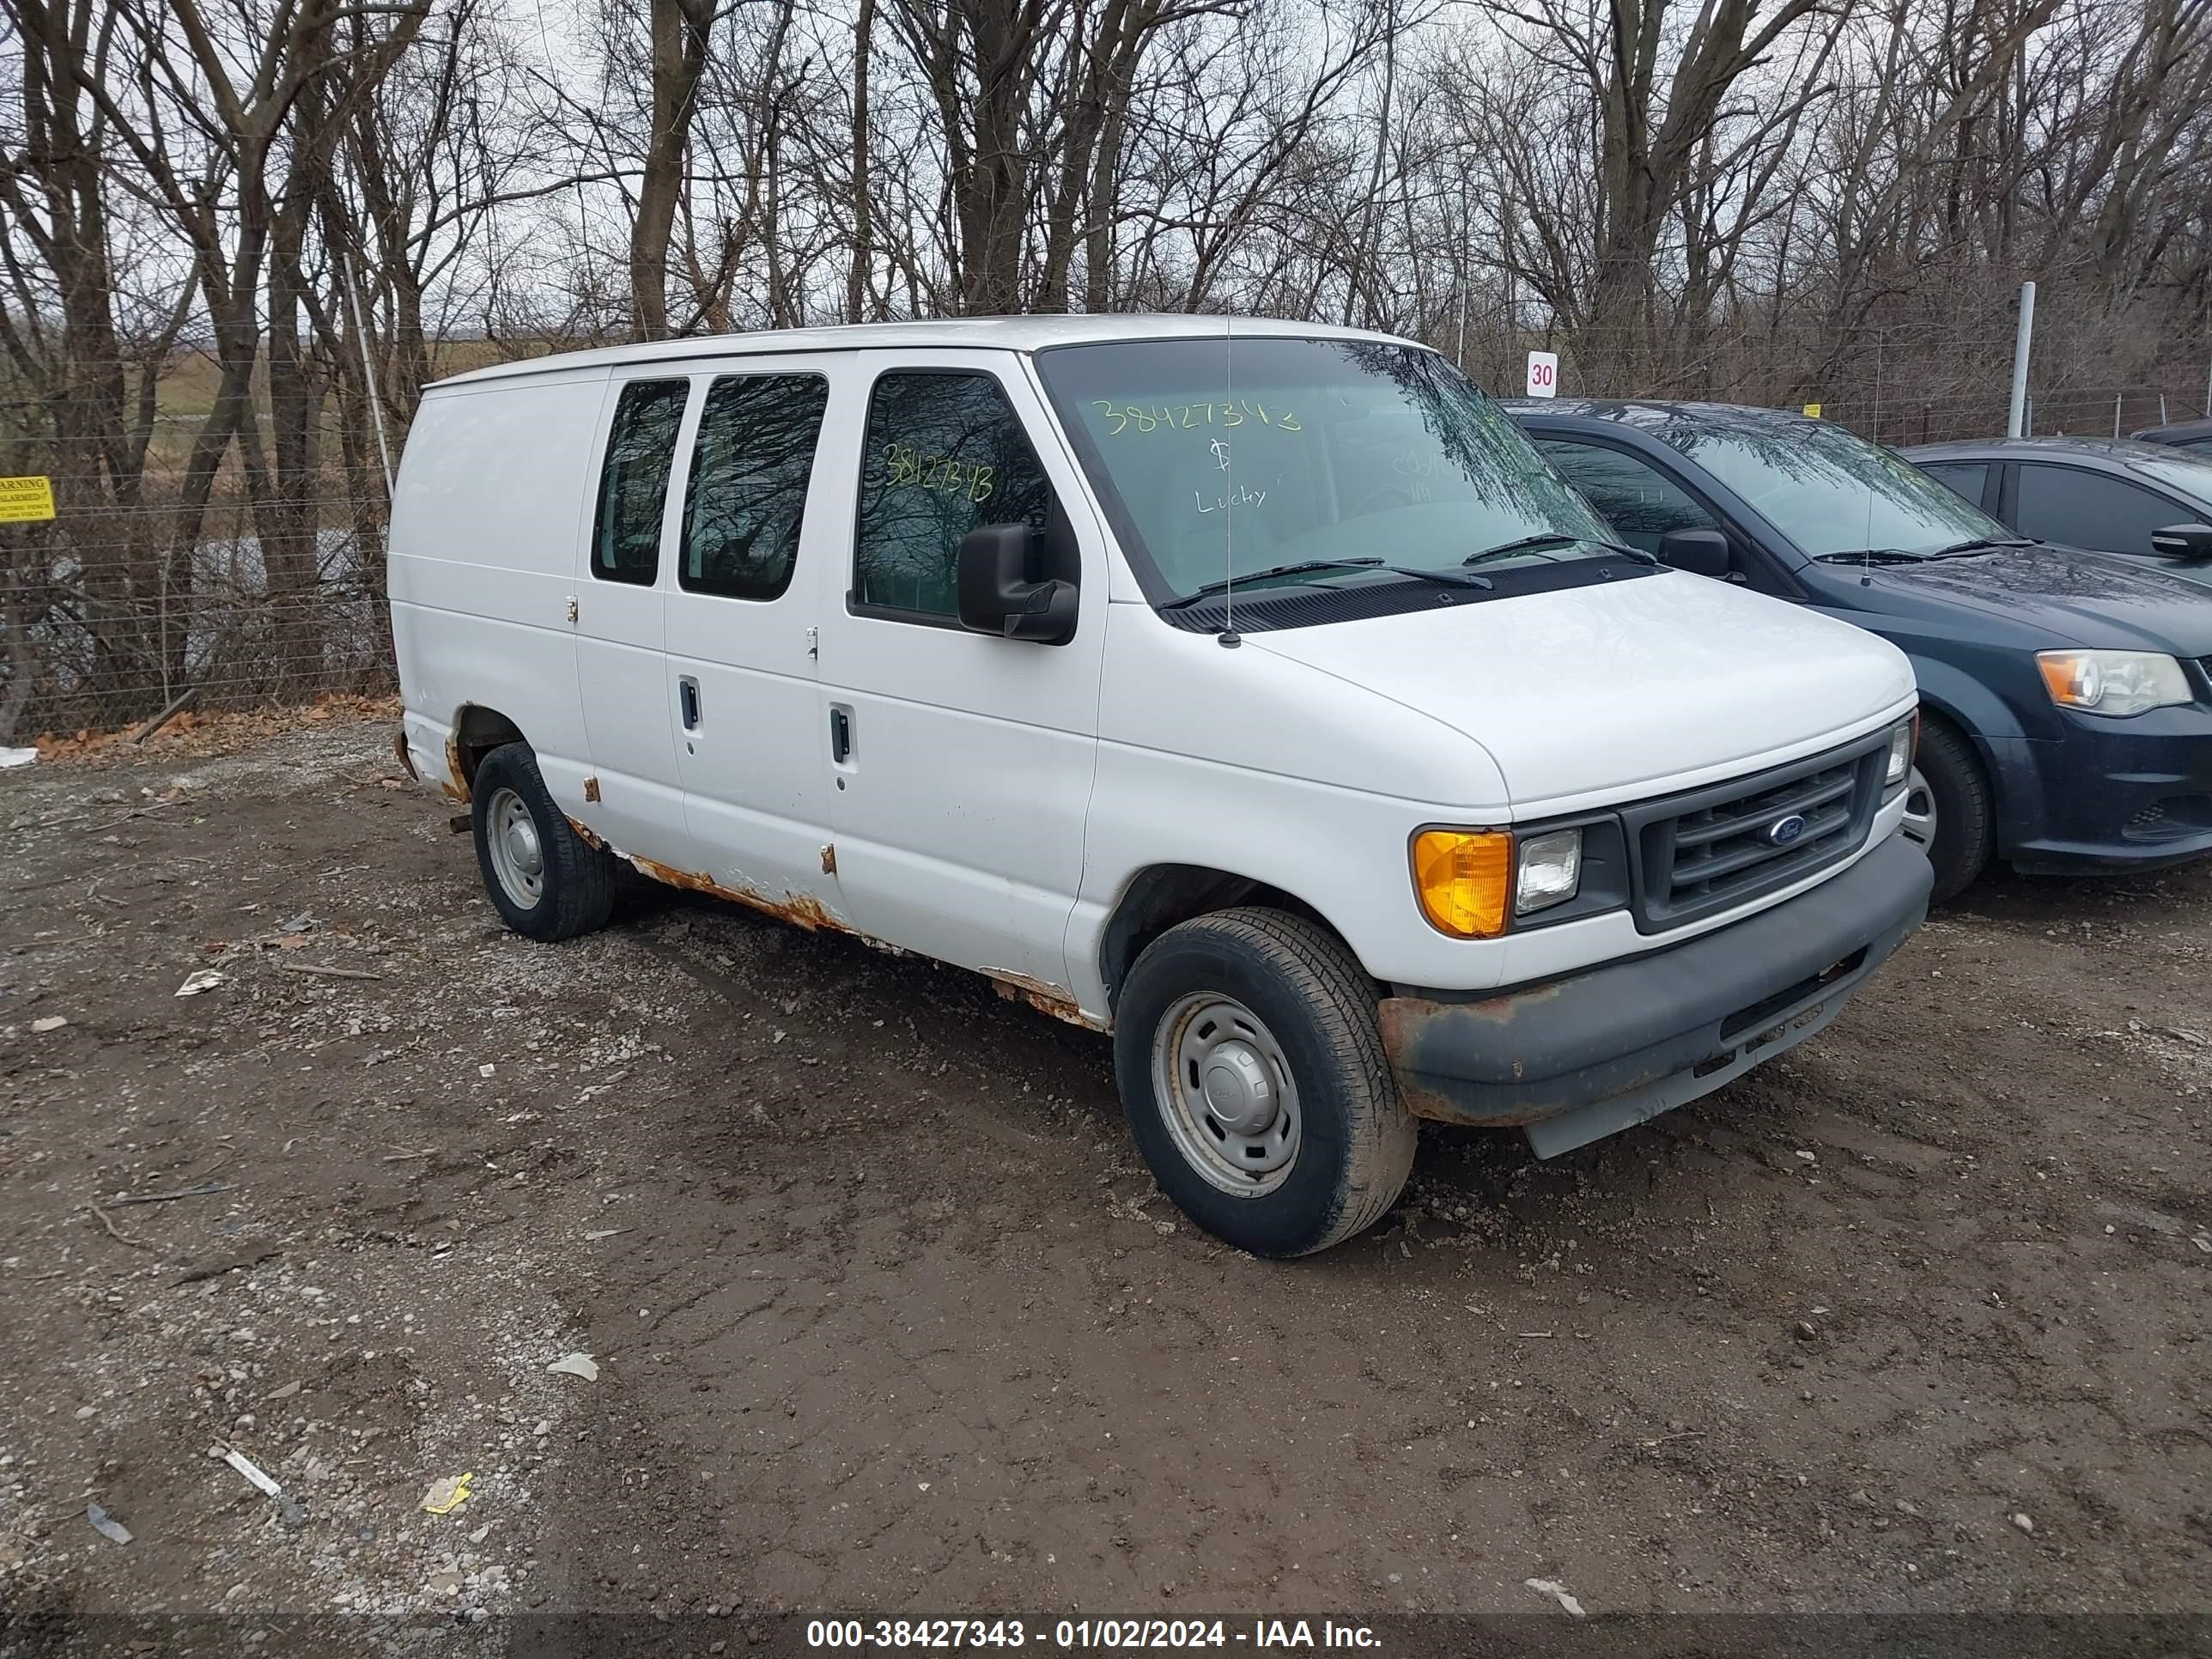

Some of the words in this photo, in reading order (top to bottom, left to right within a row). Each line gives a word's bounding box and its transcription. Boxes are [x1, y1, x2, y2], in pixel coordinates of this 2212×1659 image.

[1533, 364, 1553, 386] 30
[883, 444, 993, 501] 38427343
[0, 479, 45, 489] ARNING
